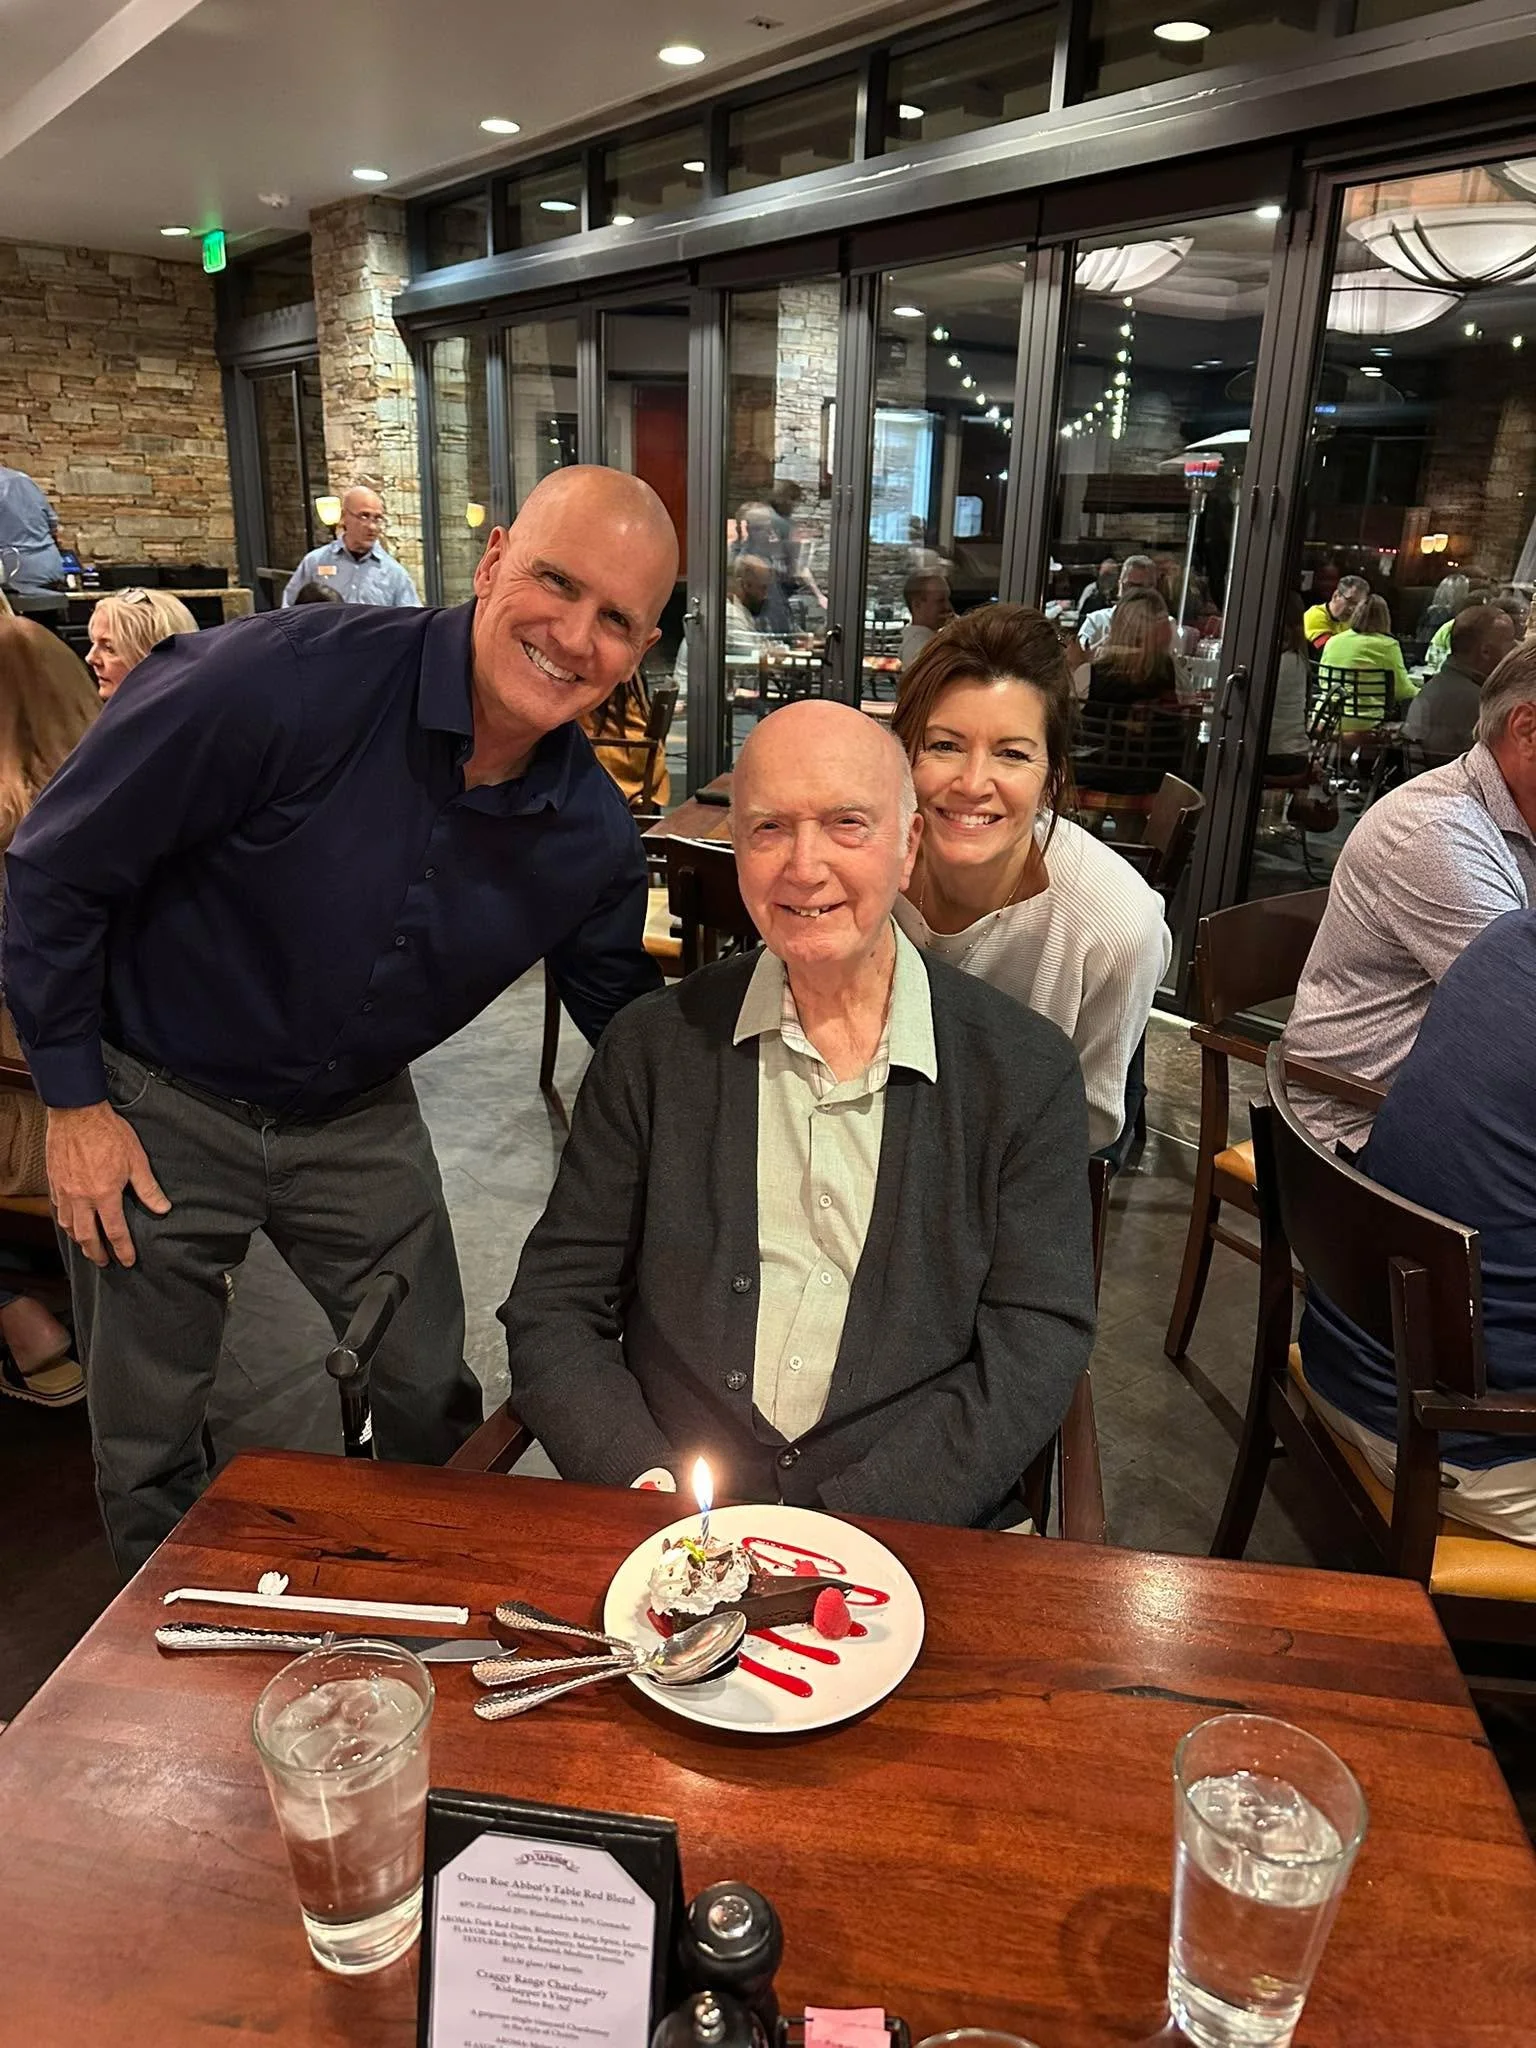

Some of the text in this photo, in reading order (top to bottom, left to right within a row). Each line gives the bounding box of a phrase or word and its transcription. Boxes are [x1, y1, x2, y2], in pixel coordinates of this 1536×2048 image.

[458, 1872, 636, 1904] Owen Roe Abbot's Table Red Blend
[507, 1891, 542, 1902] Columbia
[544, 1896, 568, 1906] Valley,
[476, 1902, 511, 1912] Zinfandel
[440, 1914, 472, 1924] AROMA:
[475, 1918, 492, 1927] Dark
[495, 1920, 509, 1929] Red
[573, 1932, 598, 1943] Baking
[453, 1925, 487, 1936] FLAVOR:
[490, 1929, 507, 1937] Dark
[463, 1935, 501, 1946] TEXTURE:
[563, 1949, 594, 1959] Medium
[476, 1969, 608, 1999] Craggy Range Chardonnay
